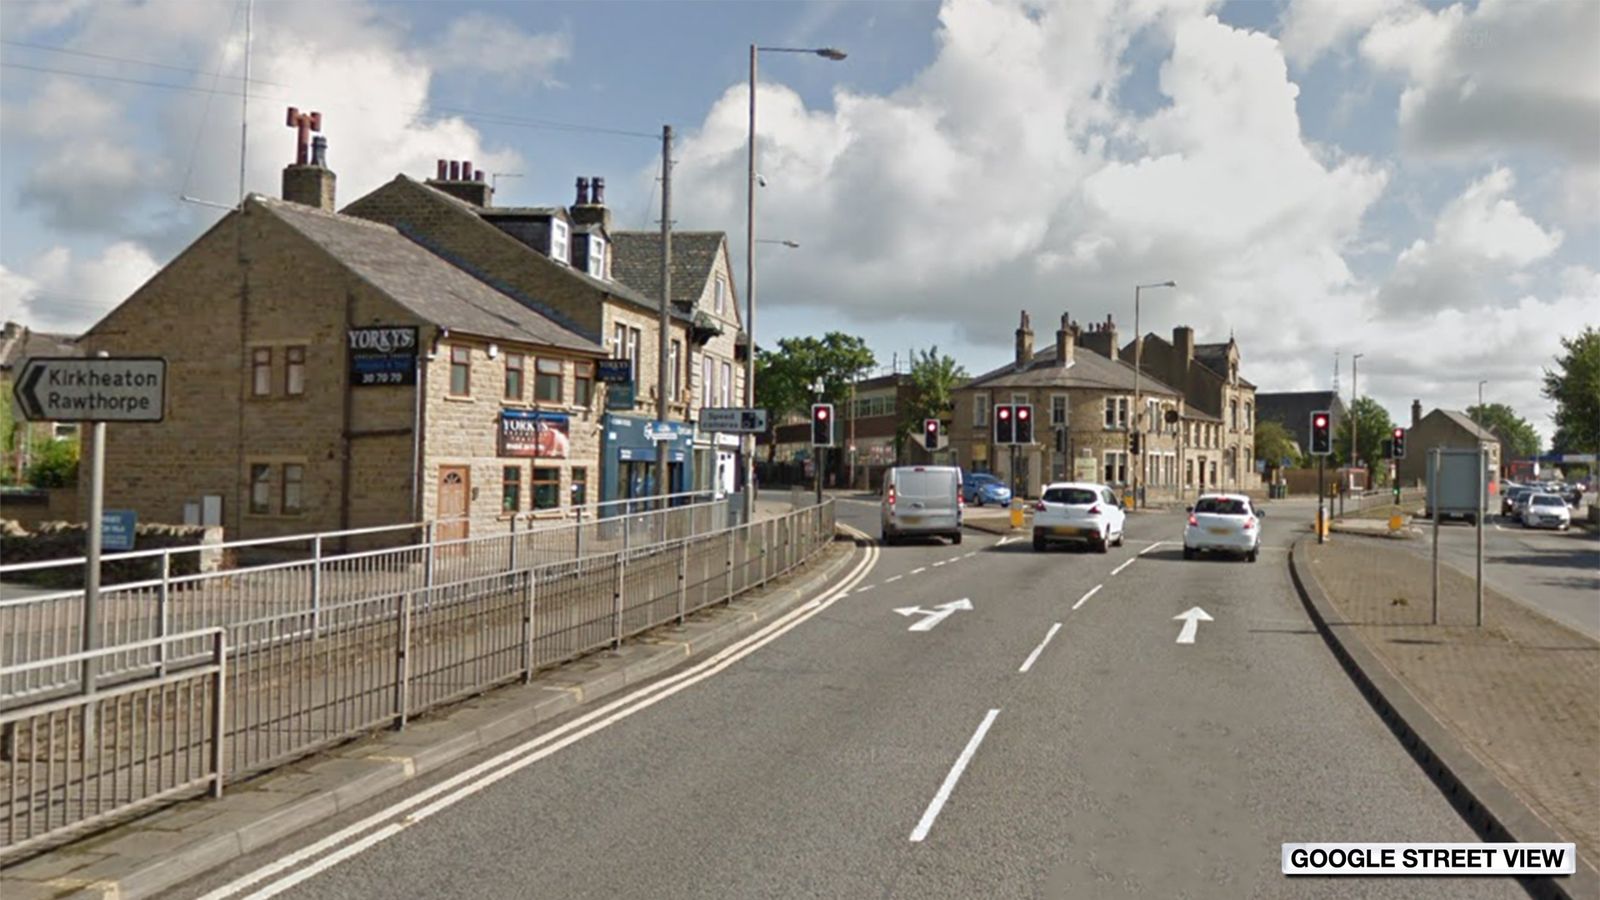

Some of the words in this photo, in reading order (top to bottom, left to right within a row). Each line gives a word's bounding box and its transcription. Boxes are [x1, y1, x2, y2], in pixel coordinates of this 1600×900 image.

[348, 328, 415, 351] YORKYS
[48, 368, 158, 388] Kirkheaton
[48, 391, 151, 414] Rawthorpe
